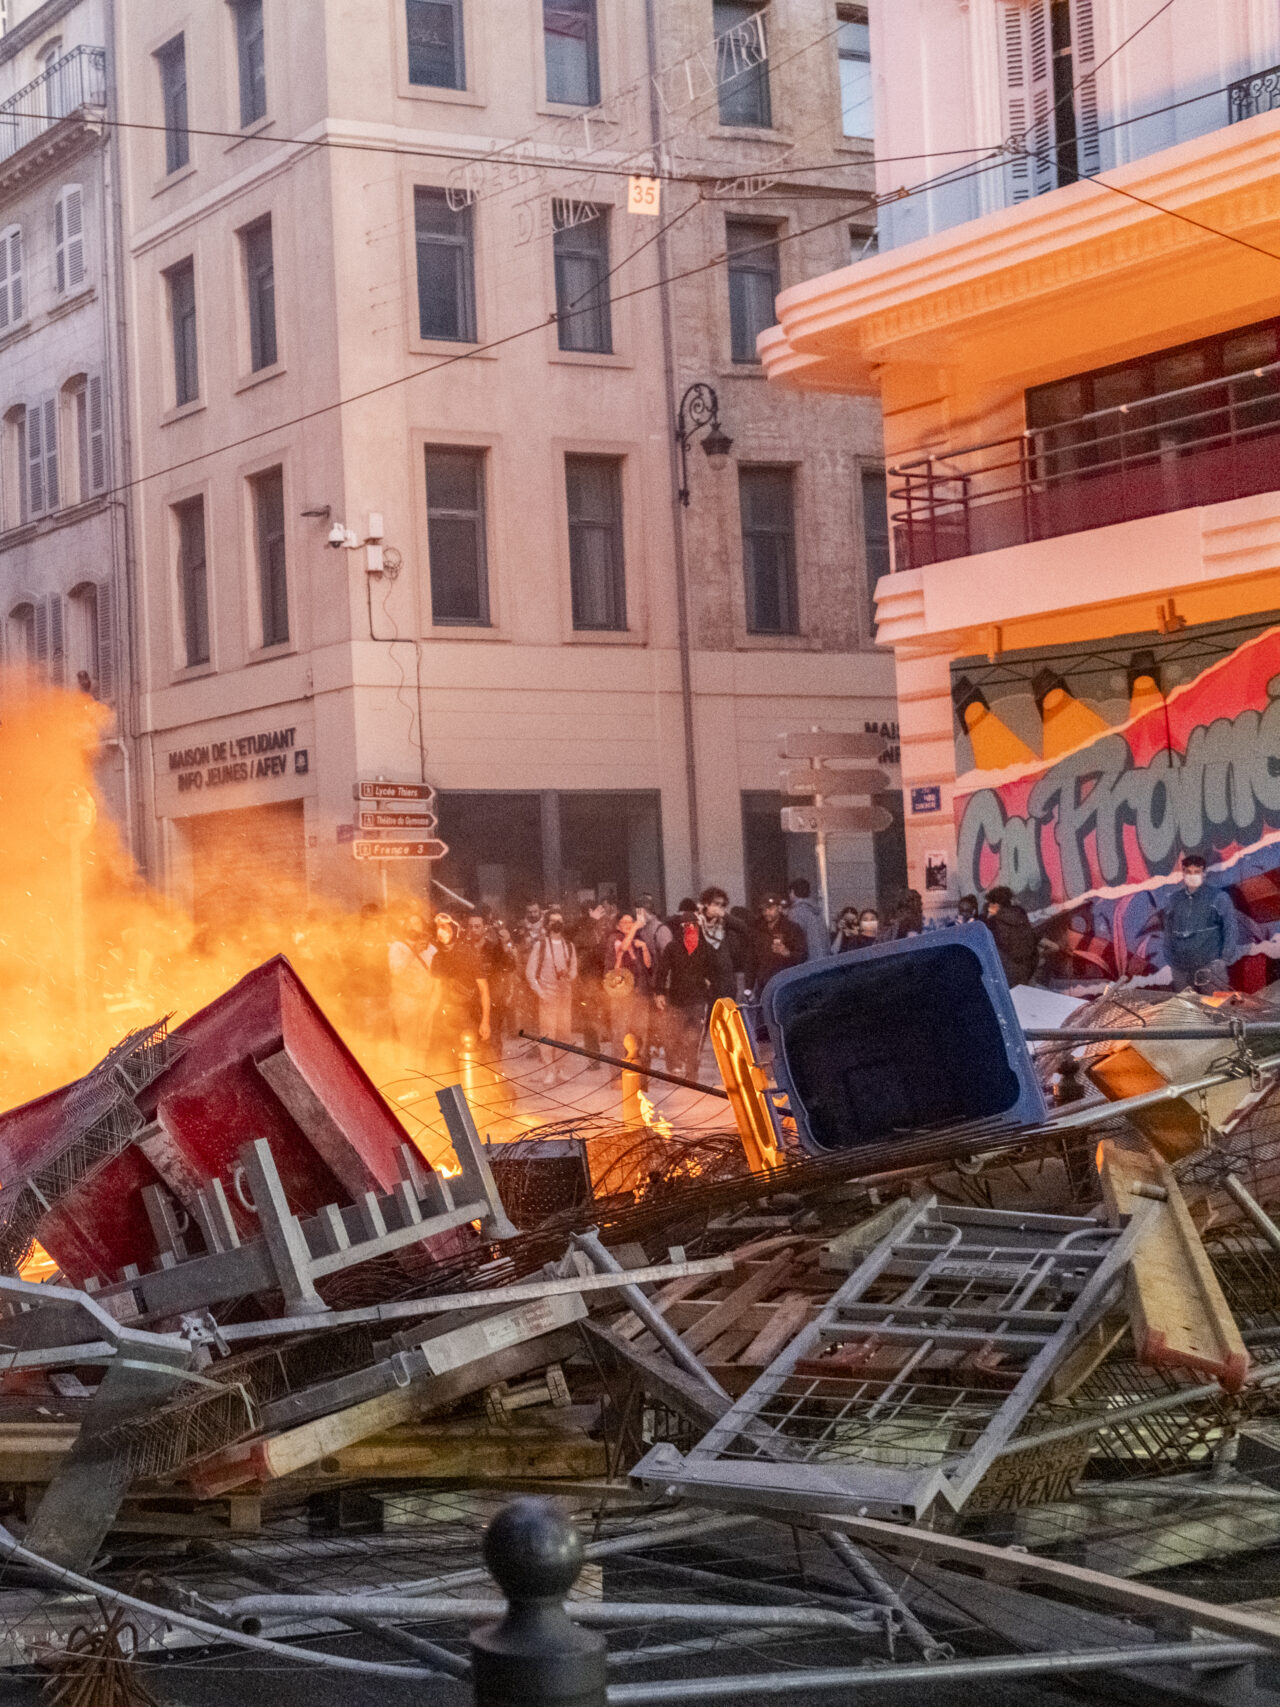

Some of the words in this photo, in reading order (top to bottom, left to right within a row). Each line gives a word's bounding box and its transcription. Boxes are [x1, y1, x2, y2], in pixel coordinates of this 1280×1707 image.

[632, 185, 655, 204] 35
[864, 722, 899, 739] MAI
[169, 746, 210, 770] MAISON
[212, 742, 227, 761] DE
[178, 771, 203, 792] INFO
[205, 762, 248, 787] JEUNES
[256, 754, 287, 778] AFEV
[375, 786, 396, 797] Lycée
[398, 787, 418, 797] Thiers
[374, 845, 410, 855] France
[417, 844, 424, 854] 3
[995, 1466, 1077, 1511] AVENIR
